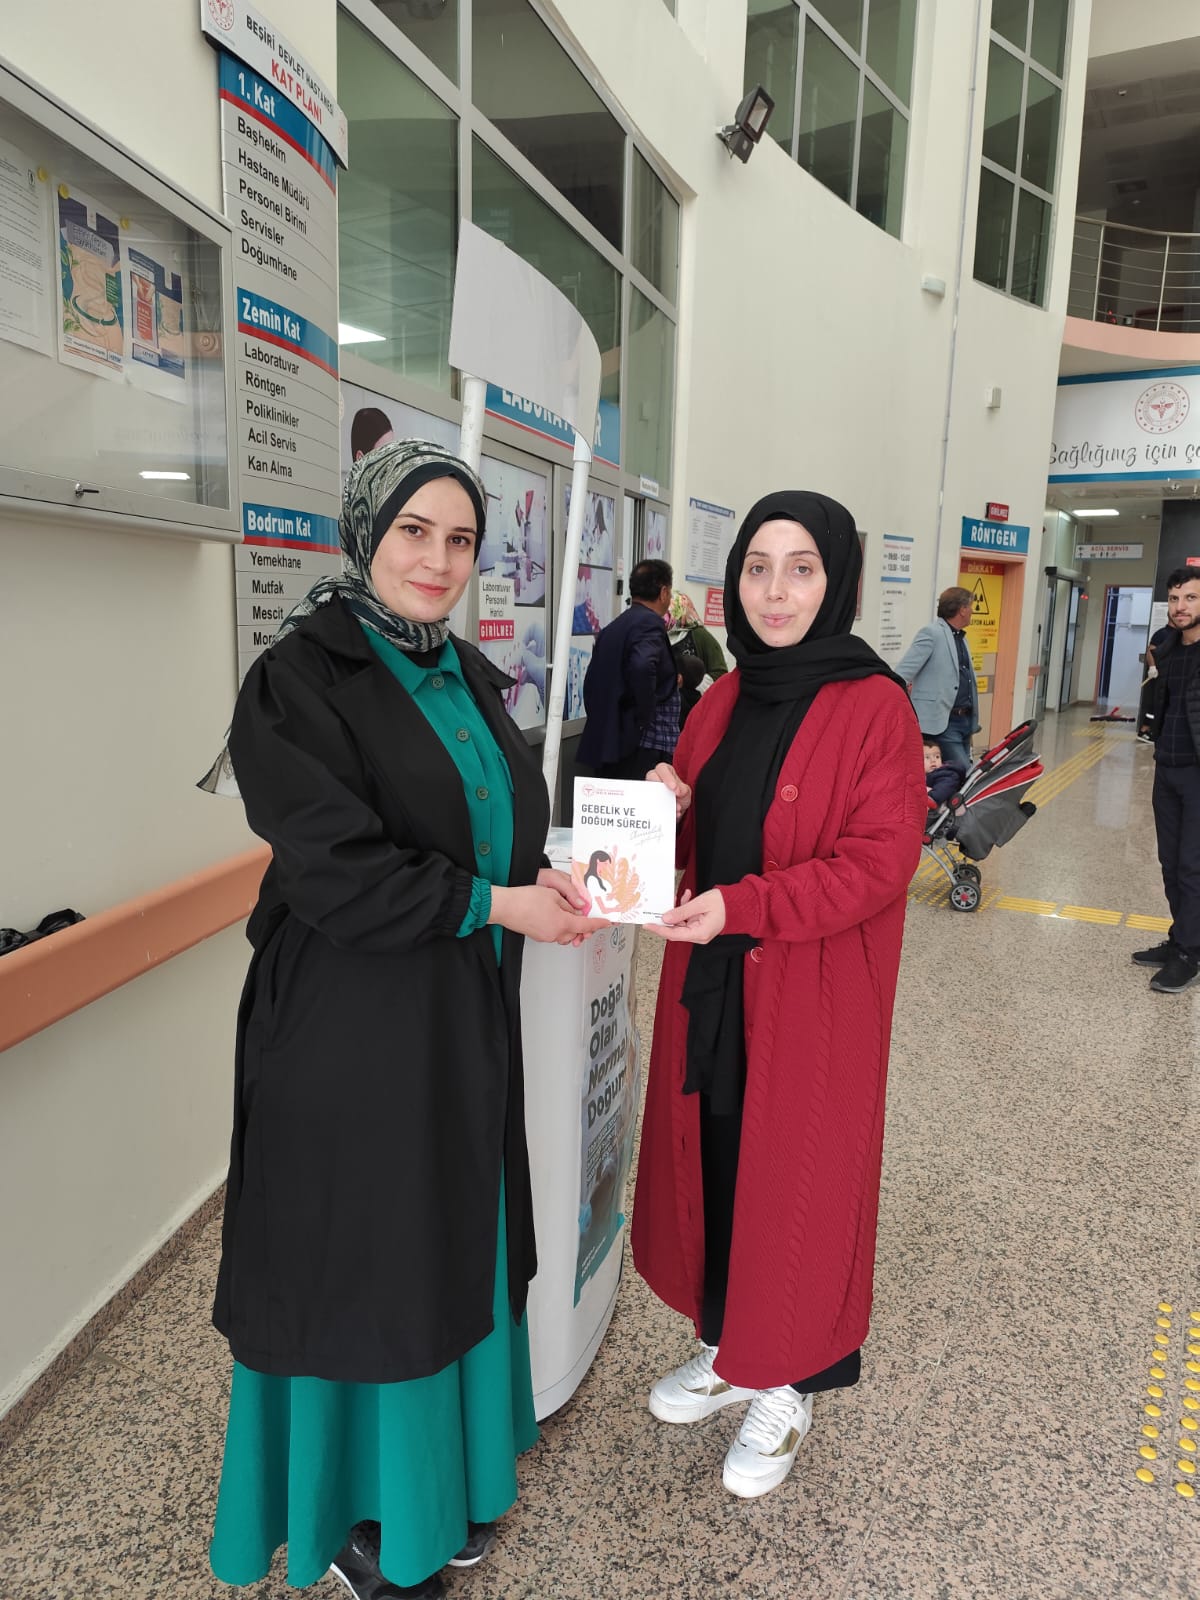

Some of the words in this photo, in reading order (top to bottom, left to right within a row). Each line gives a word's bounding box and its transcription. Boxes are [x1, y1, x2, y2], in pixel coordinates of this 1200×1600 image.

[246, 14, 275, 51] BEŞİRİ
[278, 43, 304, 80] DEVLET
[238, 72, 250, 100] 1.
[254, 81, 276, 118] Kat
[271, 58, 294, 94] KAT
[296, 84, 322, 125] PLANI
[237, 116, 287, 164] Başhekim
[238, 147, 280, 188] Hastane
[281, 176, 310, 211] Müdürü
[239, 178, 283, 218] Personel
[285, 206, 307, 235] Birimi
[240, 209, 284, 246] Servisler
[241, 237, 297, 281] Doğumhane
[242, 297, 281, 332] Zemin
[283, 312, 301, 342] Kat
[244, 342, 300, 376] Laboratuvar
[245, 370, 286, 398] Röntgen
[246, 400, 300, 428] Poliklinikler
[248, 427, 268, 445] Acil
[270, 430, 297, 453] Servis
[1145, 443, 1177, 465] için
[248, 455, 269, 472] Kan
[270, 459, 293, 478] Alma
[247, 510, 294, 536] Bodrum
[296, 516, 311, 537] Kat
[970, 522, 1017, 547] RÖNTGEN
[250, 551, 302, 569] Yemekhane
[252, 579, 284, 595] Mutfak
[252, 605, 284, 620] Mescit
[480, 622, 513, 637] GİRİLMEZ
[581, 803, 621, 815] GEBELİK
[623, 807, 636, 817] VE
[581, 815, 614, 827] DOĞUM
[616, 817, 651, 829] SÜRECİ
[590, 973, 624, 1027] Doğal
[590, 1018, 617, 1060] Olan
